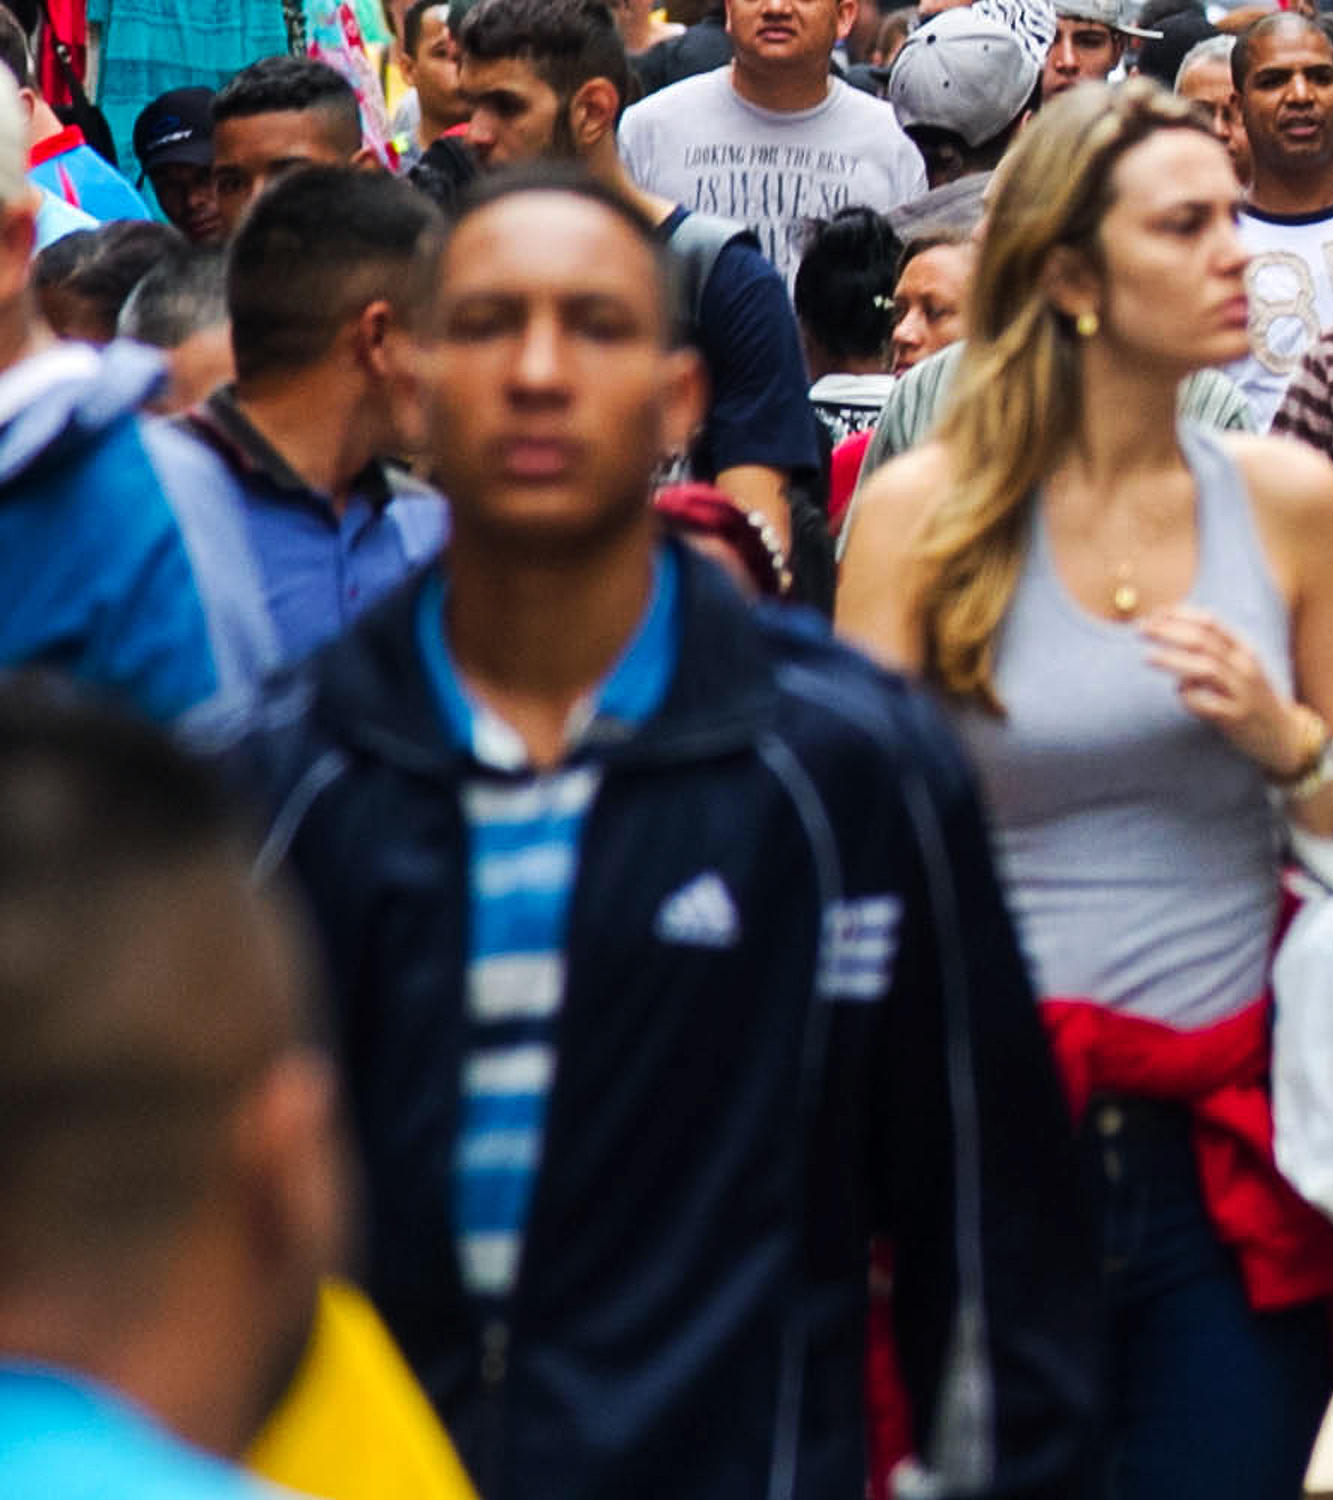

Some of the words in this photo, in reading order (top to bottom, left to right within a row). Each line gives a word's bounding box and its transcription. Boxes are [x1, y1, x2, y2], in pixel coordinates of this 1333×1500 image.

[684, 143, 745, 169] LOOKING
[749, 143, 779, 168] FOR
[785, 144, 812, 169] THE
